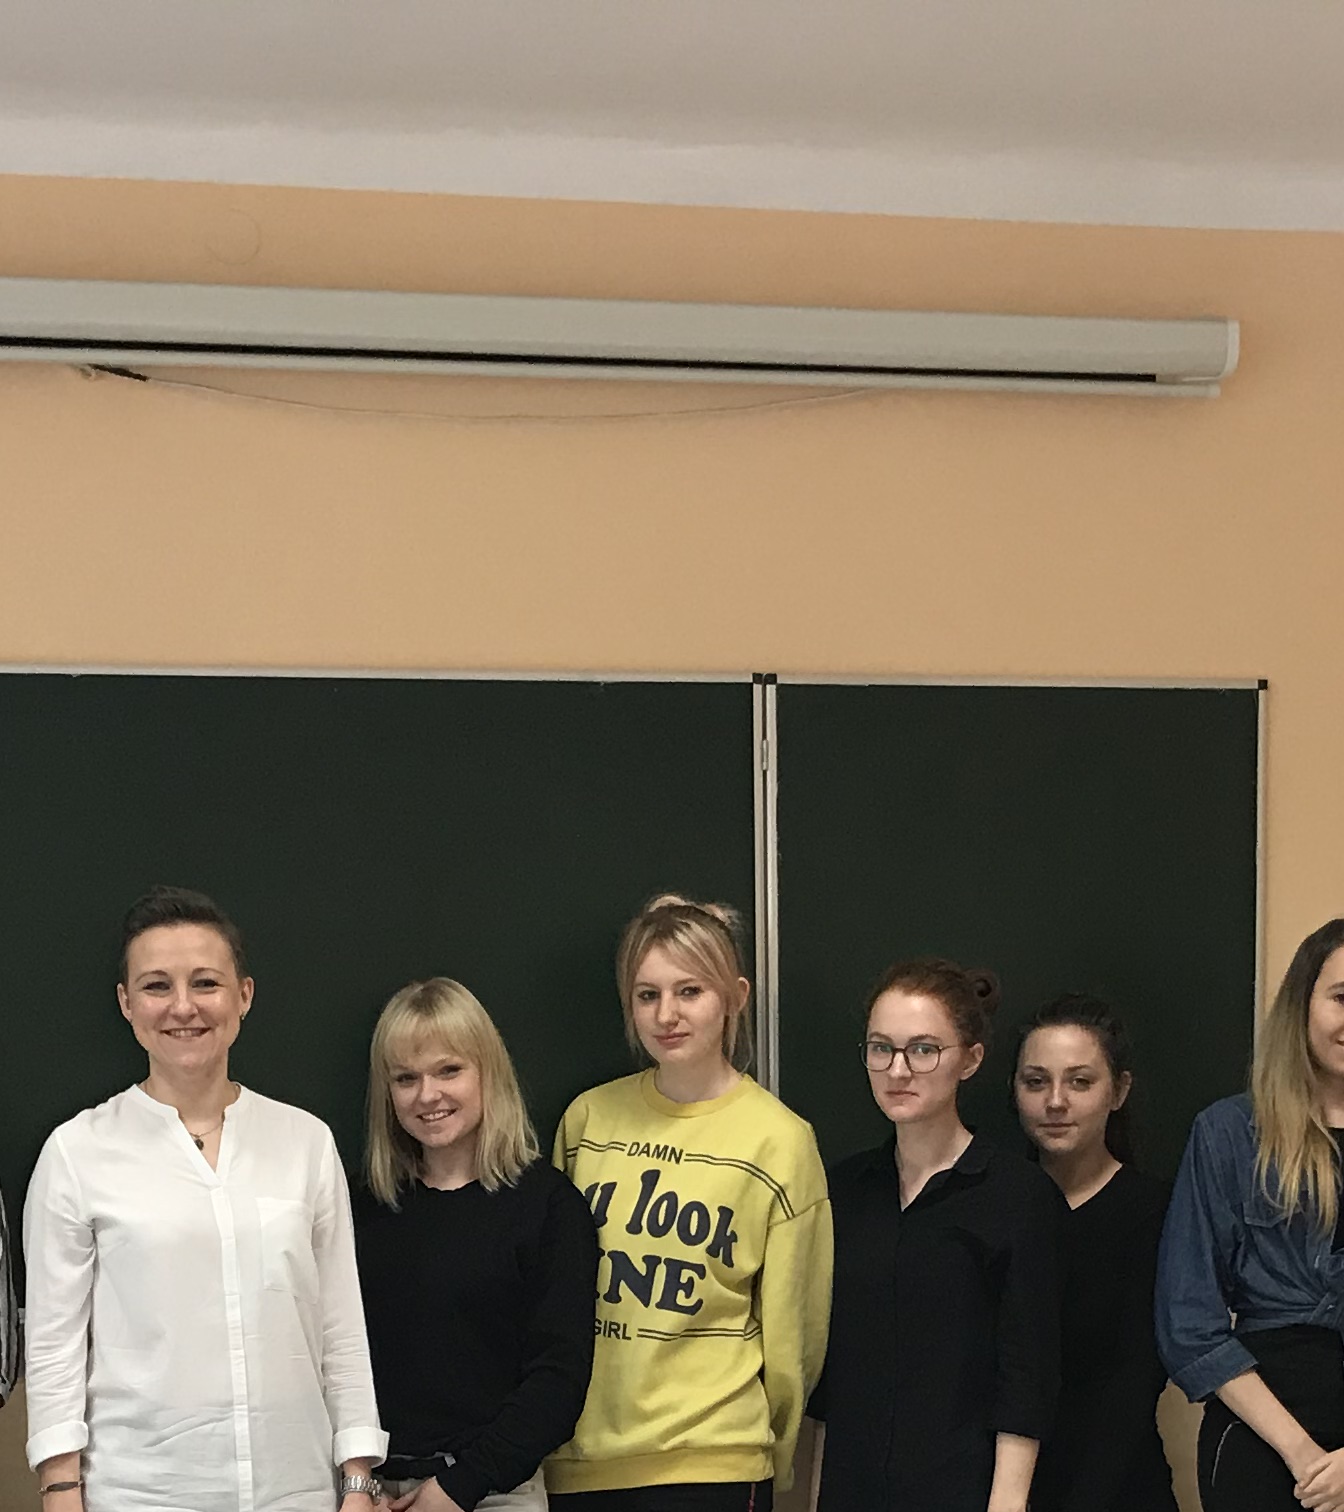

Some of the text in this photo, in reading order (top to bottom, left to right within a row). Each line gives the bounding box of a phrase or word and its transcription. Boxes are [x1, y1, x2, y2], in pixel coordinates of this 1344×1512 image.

[627, 1141, 685, 1166] DAMN
[625, 1168, 738, 1269] look
[596, 1247, 707, 1317] NE
